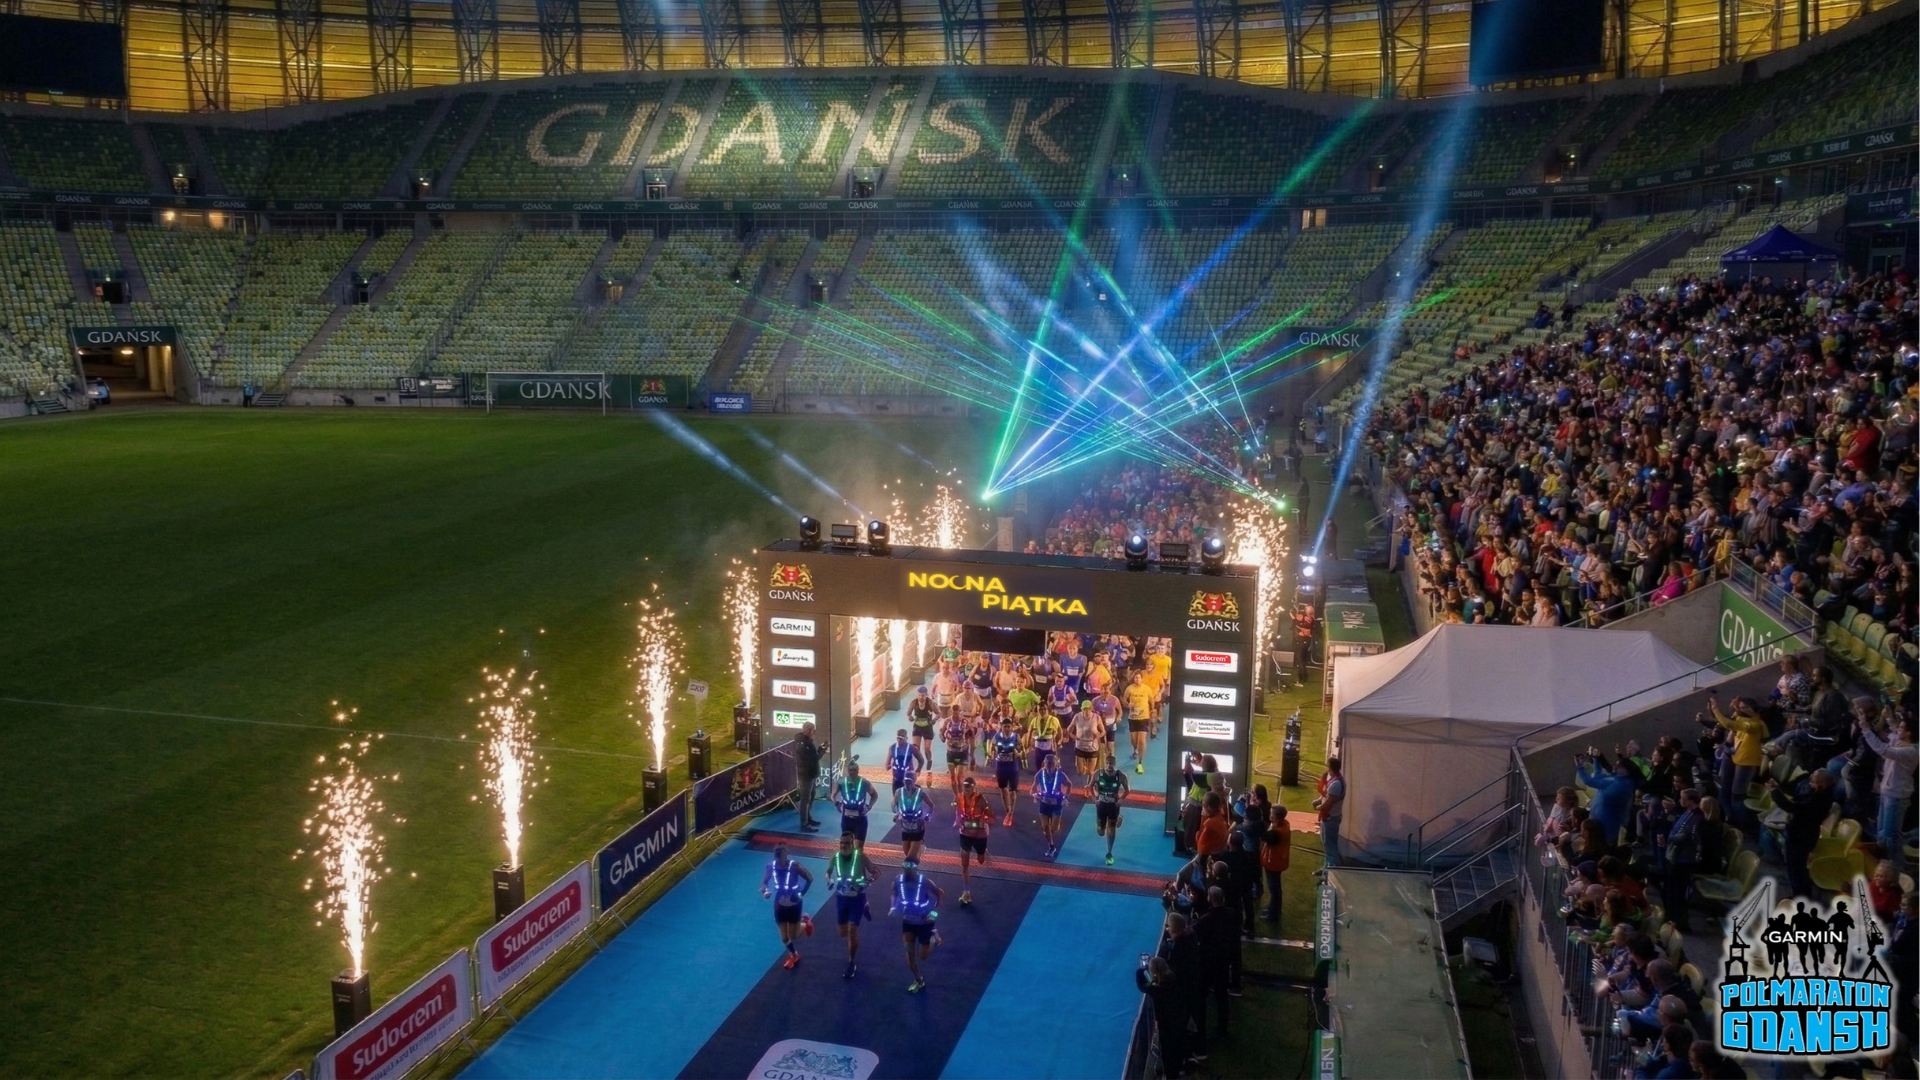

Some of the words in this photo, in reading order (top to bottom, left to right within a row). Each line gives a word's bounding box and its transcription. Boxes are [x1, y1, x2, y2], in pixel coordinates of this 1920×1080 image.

[526, 83, 1074, 166] GDAŃSK
[908, 572, 1006, 592] NOCNA
[768, 589, 815, 602] GDAŃSK
[982, 593, 1088, 616] PIĄTKA
[772, 621, 812, 632] GARMIN
[1186, 618, 1241, 632] GDAŃSK
[1191, 690, 1230, 700] BROOKS
[609, 814, 679, 885] GARMIN
